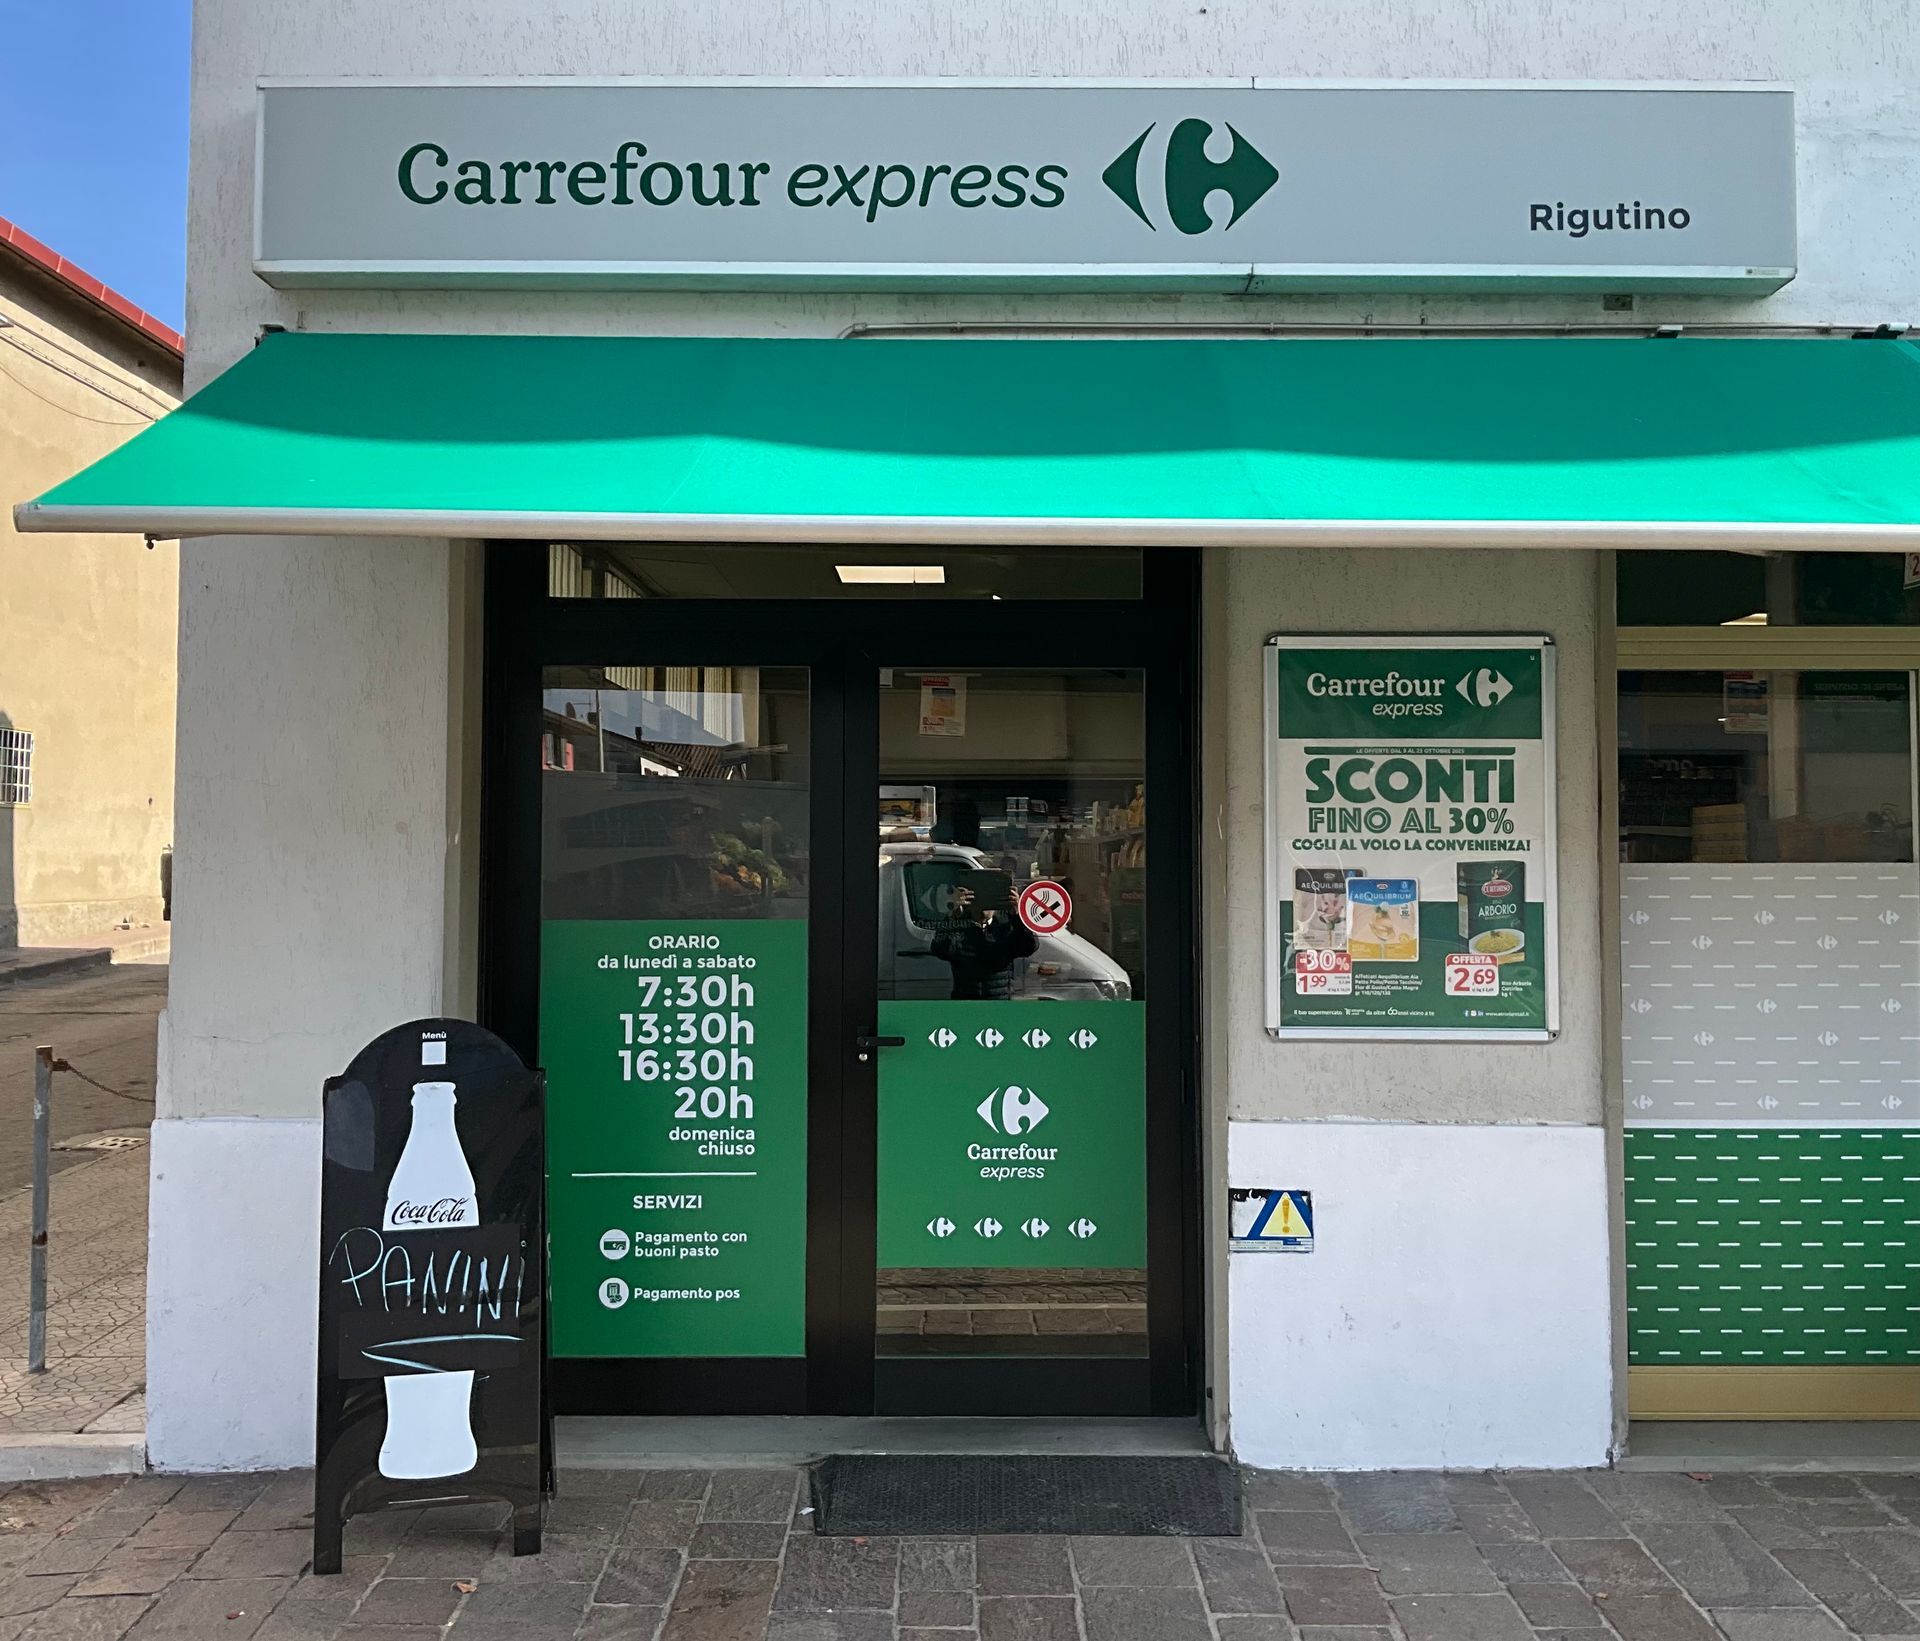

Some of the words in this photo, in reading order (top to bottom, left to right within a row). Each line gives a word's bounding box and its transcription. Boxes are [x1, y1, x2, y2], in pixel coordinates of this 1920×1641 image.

[398, 142, 770, 206] Carrefour
[787, 164, 1068, 223] express
[1530, 200, 1690, 238] Rigutino
[1306, 671, 1445, 696] Carrefour
[1372, 703, 1443, 719] express
[1305, 757, 1515, 803] SCONTI
[1309, 807, 1392, 834] FINO
[1400, 807, 1441, 833] AL
[1449, 807, 1514, 834] 30%
[1292, 838, 1337, 851] COGLI
[1339, 838, 1357, 851] AL
[1360, 838, 1402, 851] VOLO
[1404, 838, 1422, 851] LA
[1425, 839, 1531, 852] CONVENIENZA!
[1478, 903, 1517, 917] ARBORIO
[648, 935, 720, 949] ORARIO
[597, 955, 618, 969] da
[624, 954, 678, 969] lunedì
[682, 958, 692, 969] a
[697, 955, 756, 969] sabato
[1452, 956, 1492, 964] OFFERTA
[638, 974, 755, 1008] 7:30h
[422, 1031, 447, 1040] Menù
[620, 1012, 755, 1044] 13:30h
[618, 1049, 754, 1082] 16:30h
[674, 1086, 754, 1119] 20h
[668, 1126, 755, 1142] domenica
[698, 1142, 756, 1156] chiuso
[967, 1143, 1058, 1160] Carrefour
[980, 1164, 1045, 1182] express
[633, 1195, 702, 1210] SERVIZI
[391, 1198, 468, 1225] Coca-Cola
[635, 1231, 718, 1245] Pagamento
[722, 1232, 748, 1243] con
[634, 1244, 676, 1257] buoni
[679, 1246, 719, 1259] pasto
[328, 1226, 525, 1328] PANINI
[634, 1288, 712, 1302] Pagamento
[715, 1289, 740, 1302] pos
